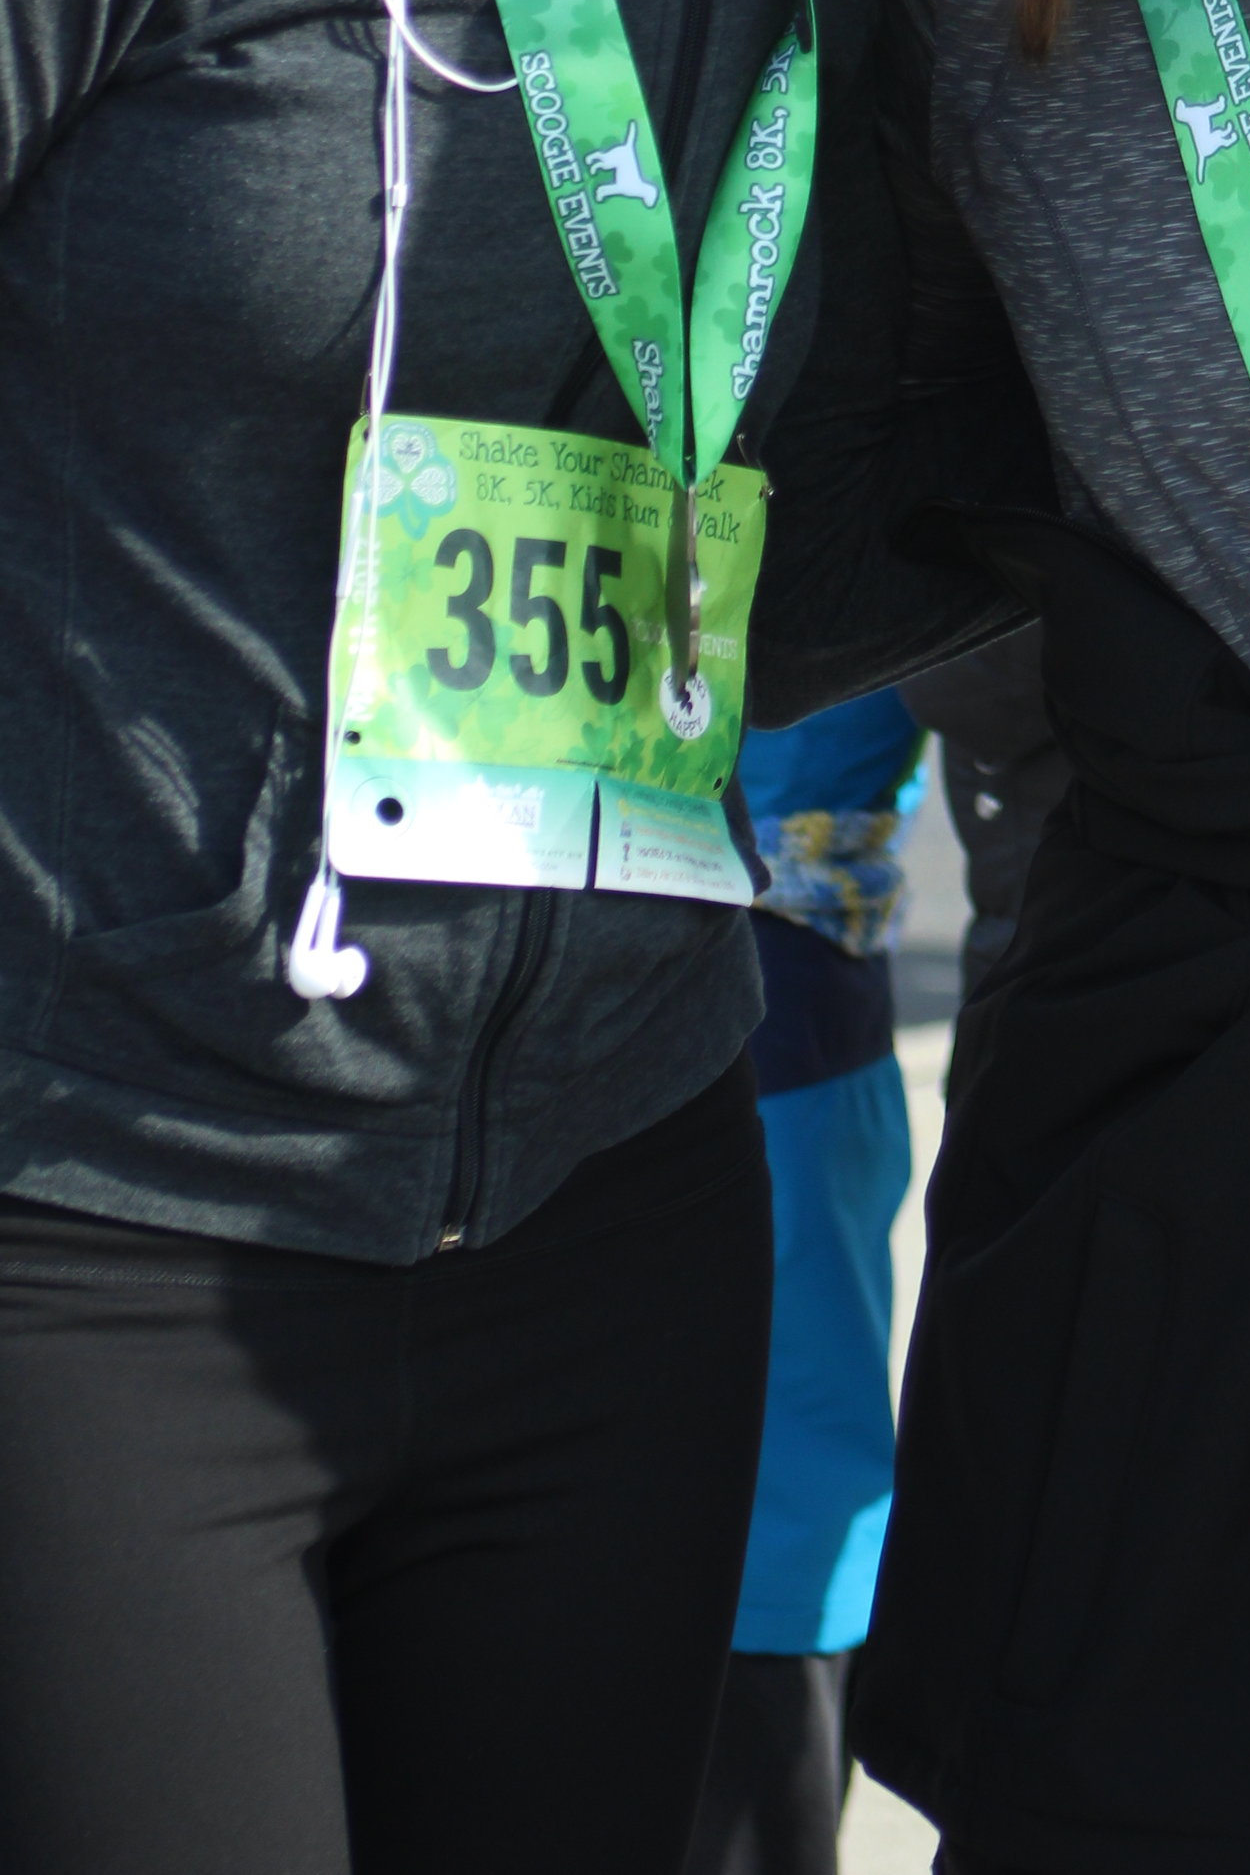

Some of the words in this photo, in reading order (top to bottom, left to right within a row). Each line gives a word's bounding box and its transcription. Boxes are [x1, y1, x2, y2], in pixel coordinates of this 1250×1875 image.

[519, 49, 582, 190] SCOOGIE
[557, 190, 620, 301] EVENTS
[730, 182, 785, 403] Shamrock
[459, 432, 538, 468] Shake
[551, 442, 604, 476] Your
[623, 494, 659, 528] Run
[425, 528, 631, 707] 355
